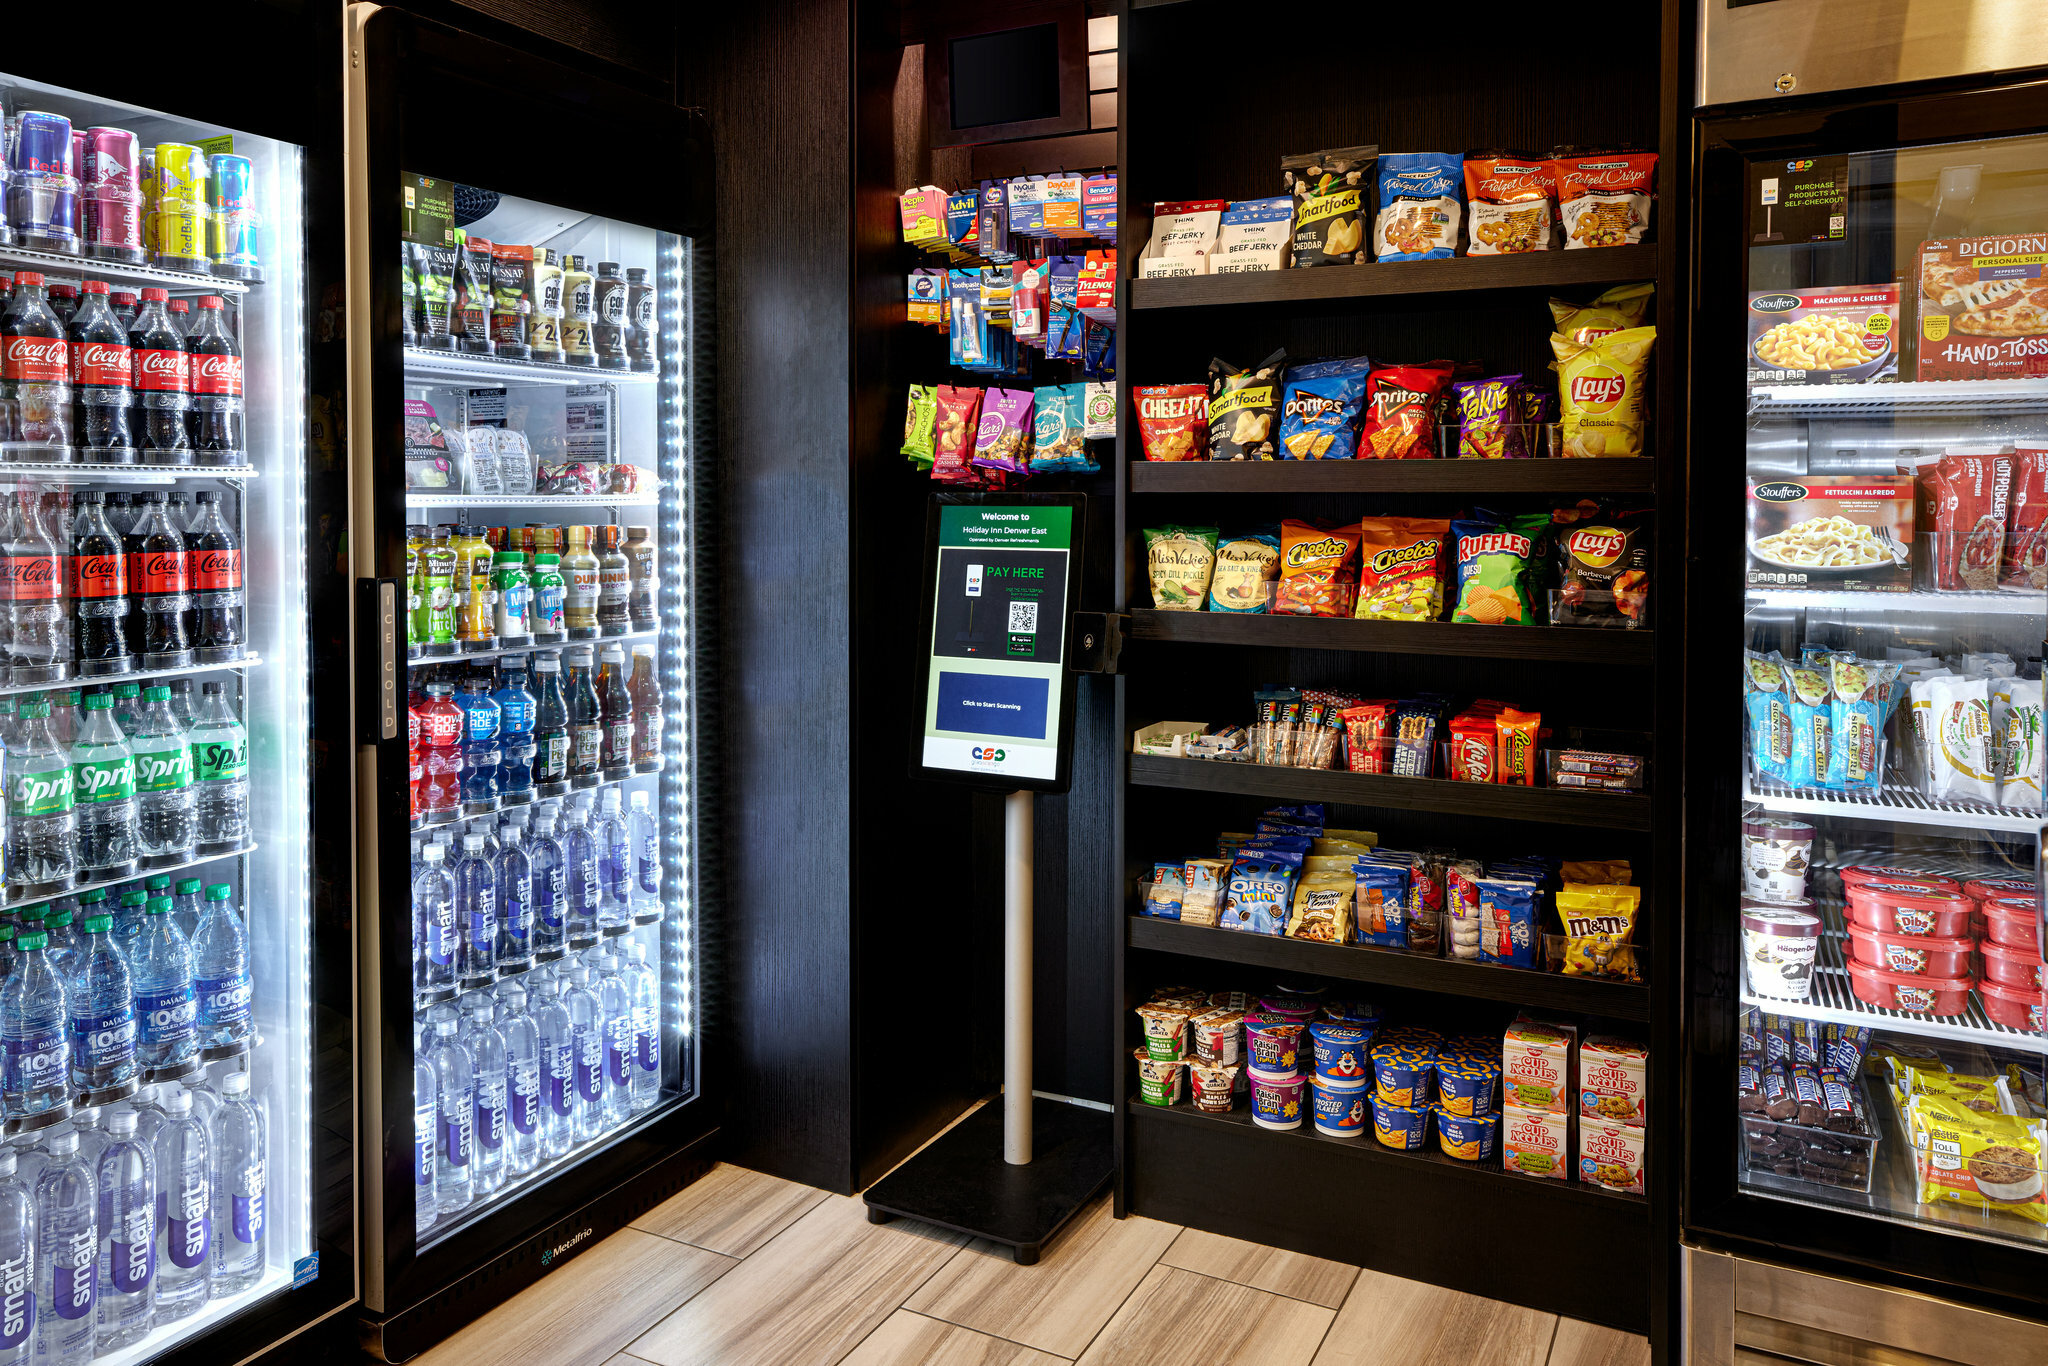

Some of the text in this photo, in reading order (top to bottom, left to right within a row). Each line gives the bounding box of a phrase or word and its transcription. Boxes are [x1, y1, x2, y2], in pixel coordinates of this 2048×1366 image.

[29, 157, 60, 172] Red
[1014, 183, 1035, 192] NyQuil
[1048, 181, 1075, 190] DayQuil
[1795, 182, 1834, 190] PURCHASE
[1789, 190, 1828, 199] PRODUCTS
[424, 198, 446, 206] PURCHASE
[903, 196, 925, 206] Pepto
[949, 198, 974, 211] Advil
[1785, 197, 1844, 207] SELF-CHECKOUT
[422, 203, 443, 212] PRODUCTS
[419, 209, 452, 219] SELF-CHECKOUT
[124, 222, 133, 245] Red
[181, 213, 192, 254] Red Bull
[1179, 232, 1205, 240] JERKY
[1297, 232, 1317, 241] WHITE
[1230, 243, 1278, 253] BEEF JERKY
[1293, 241, 1322, 251] CHEDDAR
[1146, 268, 1196, 279] BEEF JERKY
[1218, 264, 1270, 274] BEEF JERKY
[1079, 281, 1113, 289] TYLENOL
[1756, 298, 1795, 309] Stouffer's
[1813, 296, 1851, 304] MACARONI
[1574, 376, 1622, 403] Lay's
[1209, 392, 1266, 418] Smartfood
[1286, 399, 1343, 416] Doritos
[1579, 418, 1615, 427] Classic
[1967, 458, 1976, 477] PIZZA
[1974, 458, 1983, 496] PEPPERONI
[1759, 486, 1801, 498] Stouffer's
[963, 526, 989, 535] Holiday
[1459, 534, 1530, 563] RUFFLES
[1573, 531, 1624, 558] Lay's
[1290, 538, 1348, 566] Cheetos
[1371, 541, 1438, 572] Cheetos
[1150, 549, 1209, 569] Miss Vickie's
[987, 567, 1044, 578] PAY HERE
[1153, 571, 1204, 579] SPICY PICKLE
[1463, 564, 1482, 577] QUESO
[1578, 569, 1611, 580] Barbecue
[385, 662, 393, 727] COLD
[997, 703, 1021, 711] Scanning
[1262, 702, 1270, 721] KIND
[1772, 702, 1781, 760] SIGNATURE
[2009, 719, 2019, 738] EGG
[1815, 717, 1824, 780] SIGNATURE
[1850, 715, 1858, 776] SIGNATURE
[1230, 881, 1285, 894] OREO
[1240, 891, 1276, 903] mini
[437, 899, 452, 956] smart
[1901, 916, 1929, 929] Dibs
[1891, 956, 1919, 967] Dibs
[221, 977, 244, 989] DASANI
[161, 995, 186, 1006] DASANI
[1901, 995, 1929, 1007] Dibs
[208, 1005, 237, 1013] RECYCLED
[148, 1024, 178, 1032] RECYCLED
[89, 1044, 120, 1055] RECYCLED
[1253, 1038, 1279, 1051] Raisin
[1256, 1049, 1276, 1058] Bran
[1521, 1056, 1548, 1068] CUP
[1510, 1064, 1558, 1080] NOODLES
[1599, 1068, 1627, 1079] CUP
[1588, 1074, 1636, 1092] NOODLES
[1256, 1088, 1281, 1100] Raisin
[1258, 1099, 1279, 1109] Bran
[1316, 1098, 1342, 1107] FROSTED
[1522, 1124, 1548, 1136] CUP
[1511, 1130, 1558, 1148] NOODLES
[1598, 1136, 1625, 1148] CUP
[1587, 1141, 1635, 1162] NOODLES
[1934, 1143, 1954, 1152] TOLL
[185, 1181, 205, 1257] smart
[129, 1205, 147, 1282] smart
[553, 1227, 593, 1256] Metalfrio
[73, 1229, 92, 1308] smart
